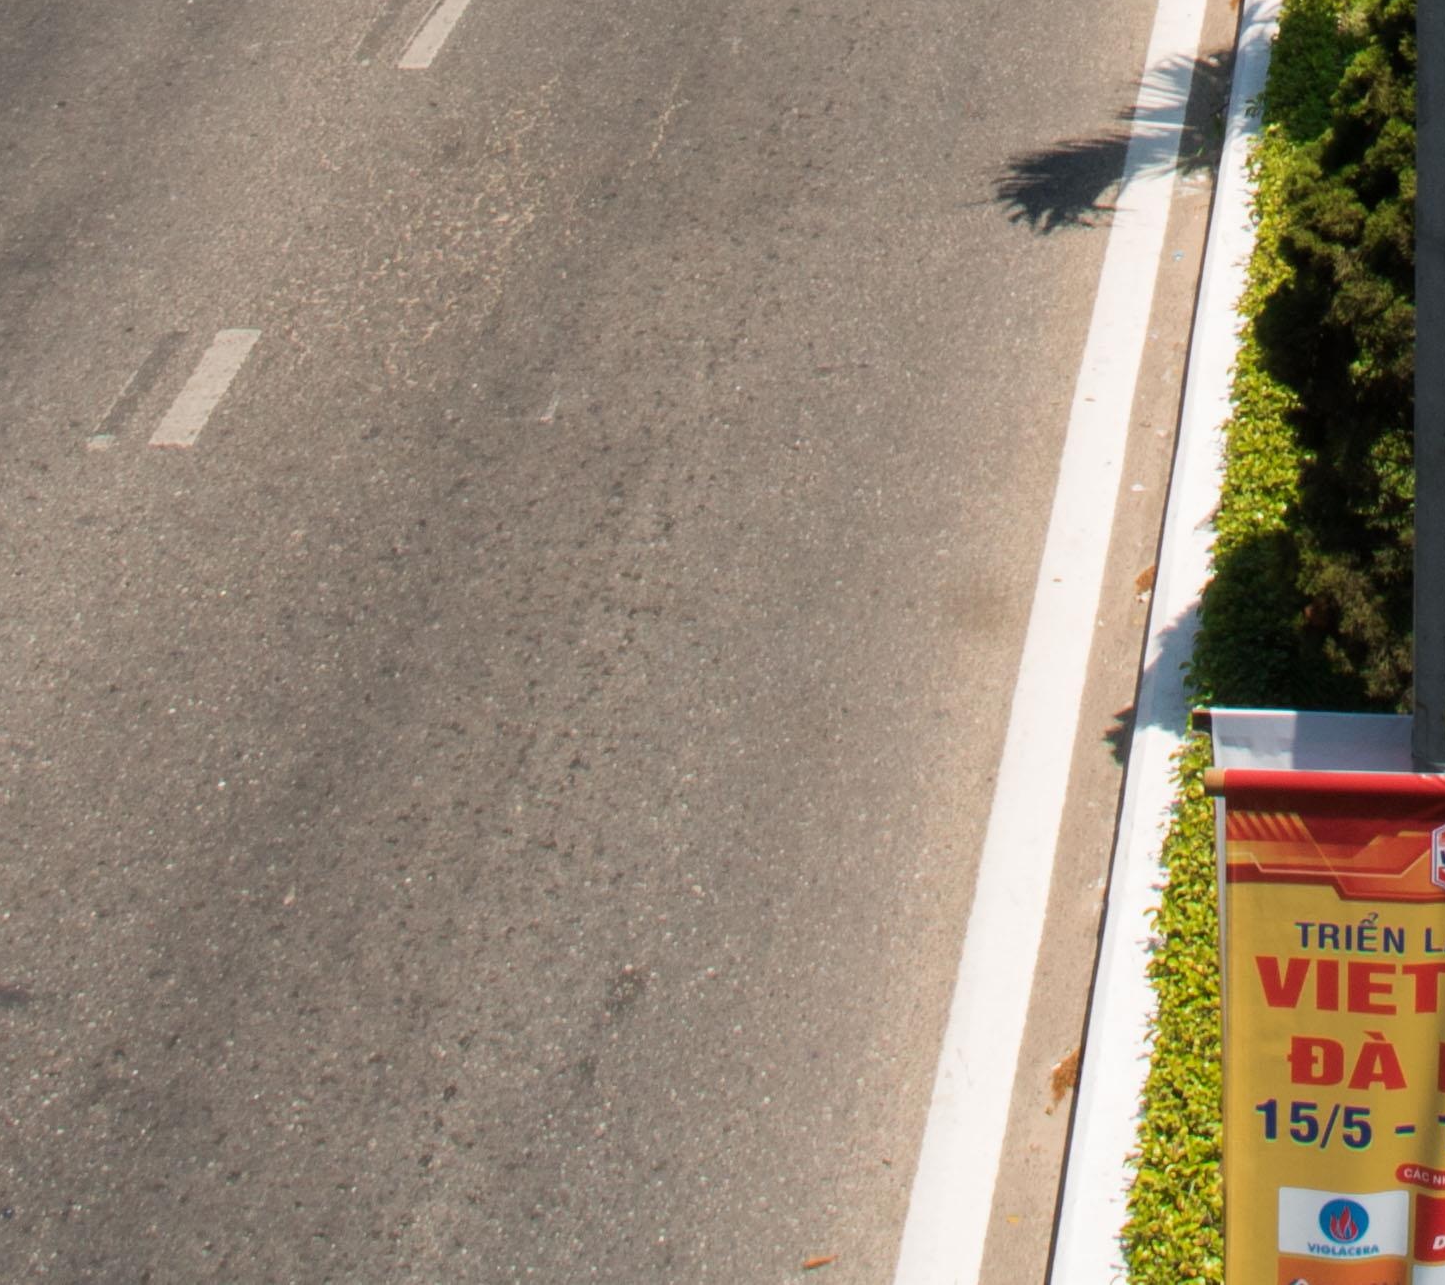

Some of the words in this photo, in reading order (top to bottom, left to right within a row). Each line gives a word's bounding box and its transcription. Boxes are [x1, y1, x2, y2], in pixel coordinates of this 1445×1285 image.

[1295, 912, 1405, 954] TRIỂN
[1287, 1031, 1407, 1090] ĐÀ
[1255, 1099, 1373, 1151] 15/5
[1395, 1124, 1416, 1136] -
[1404, 1166, 1429, 1180] CÁC
